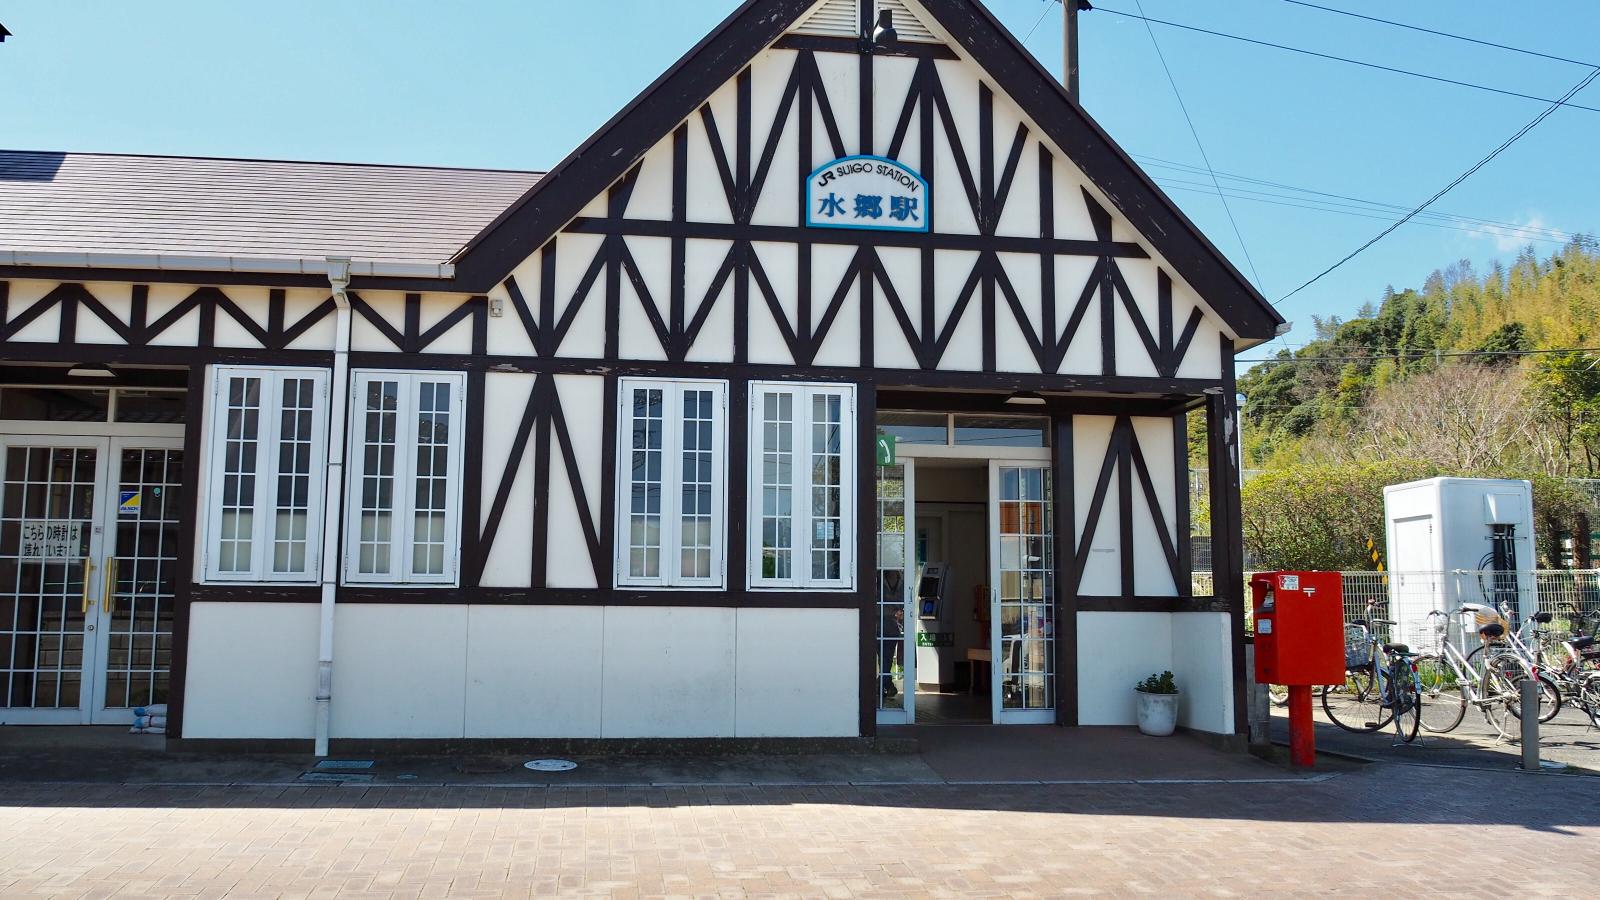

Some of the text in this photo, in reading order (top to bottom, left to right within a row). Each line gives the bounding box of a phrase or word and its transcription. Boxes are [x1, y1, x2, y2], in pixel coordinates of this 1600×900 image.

[818, 162, 919, 192] JR SUIGO STATION
[817, 192, 919, 222] 水郷駅
[24, 524, 78, 541] こちらの時計は
